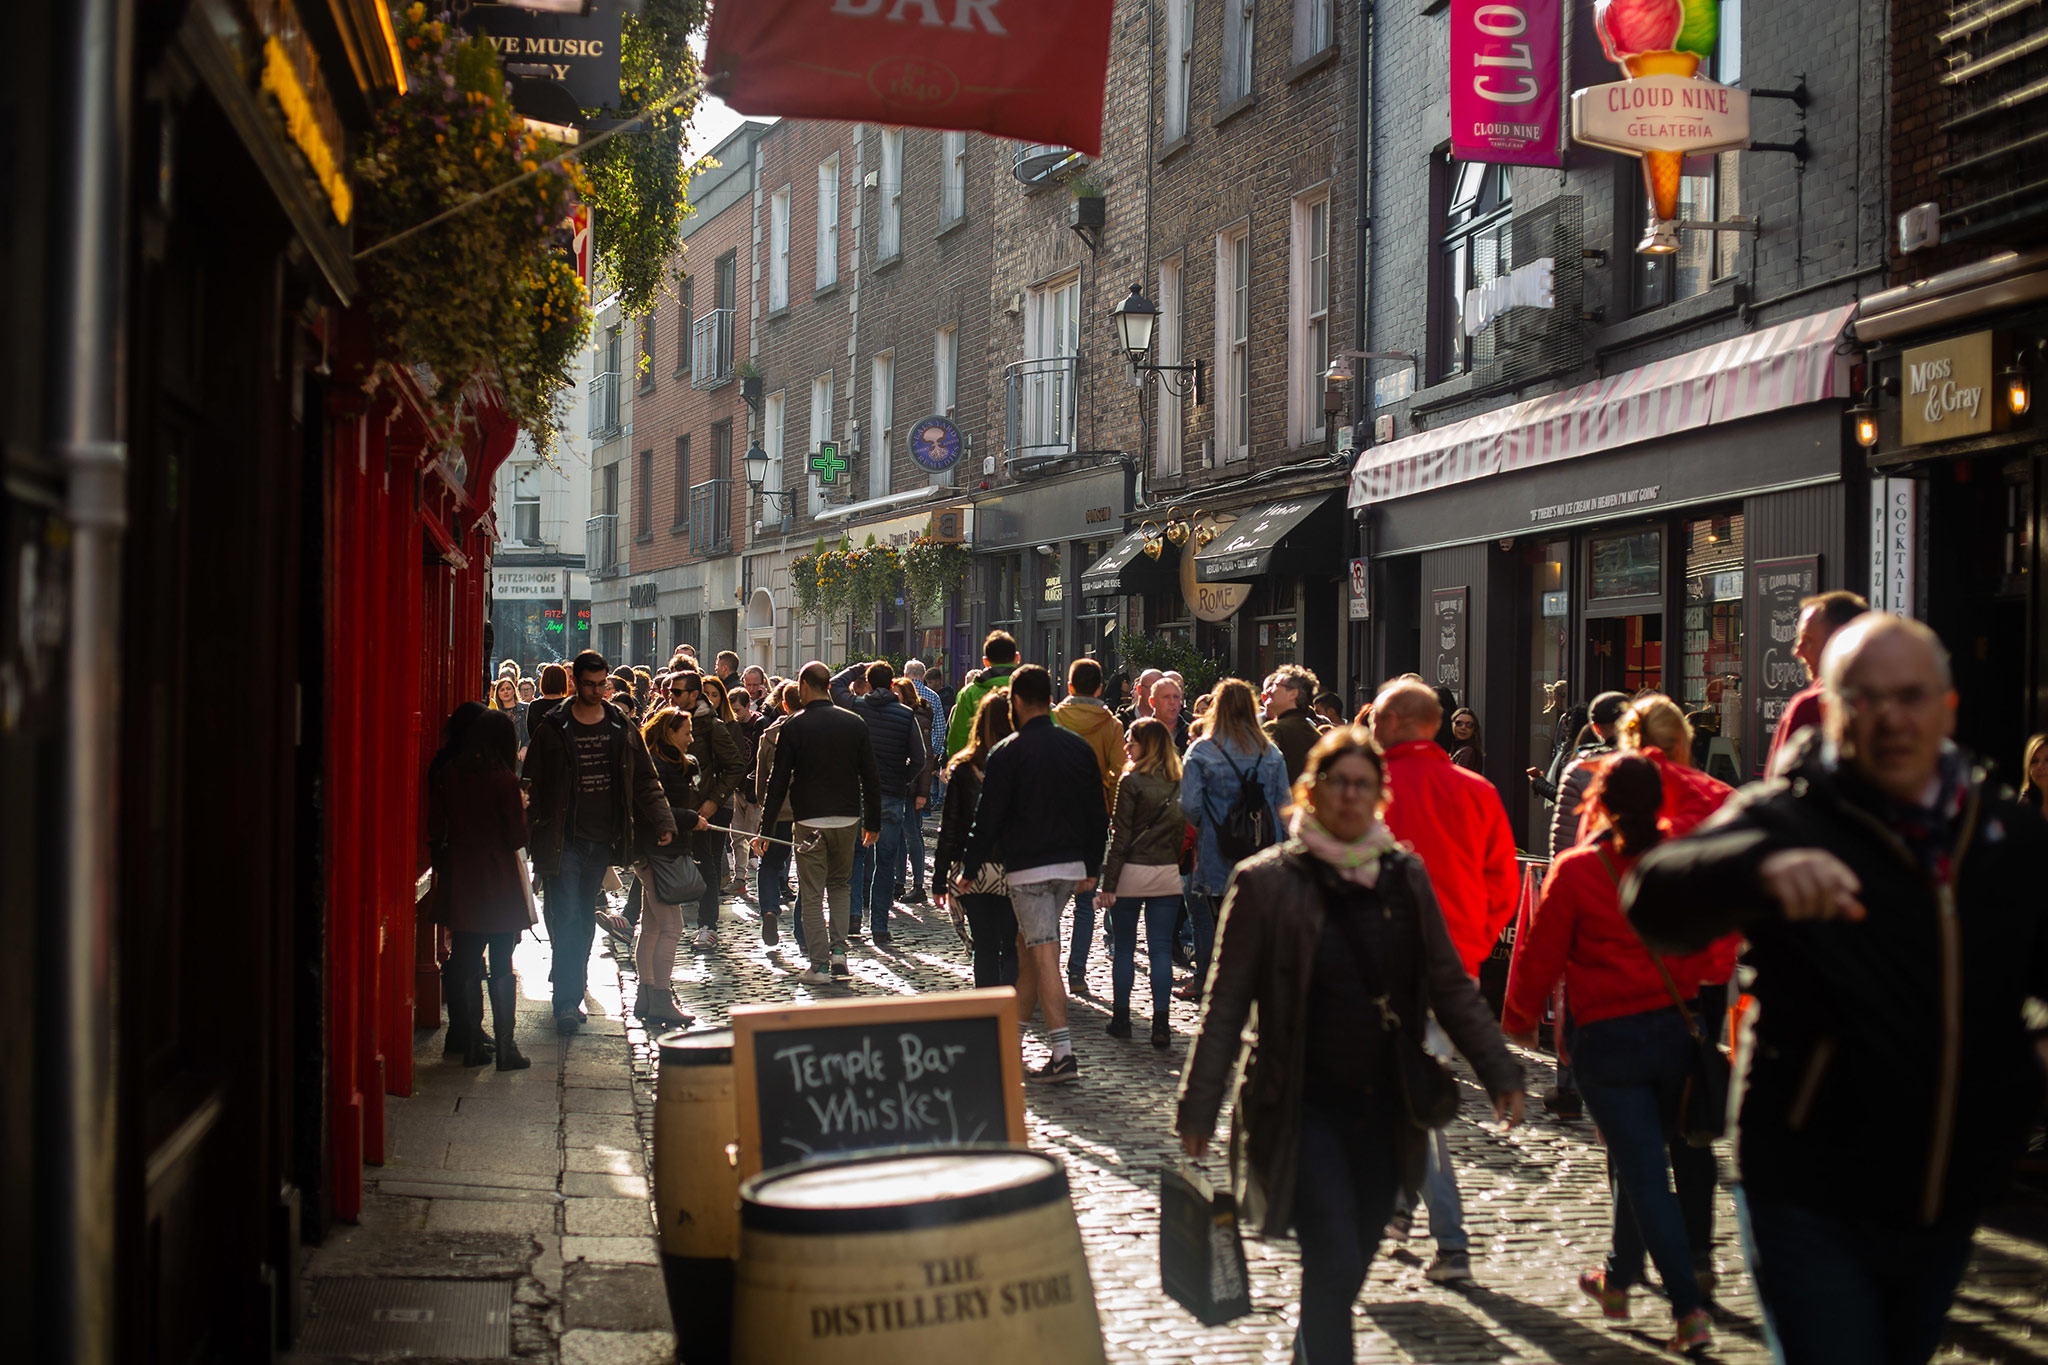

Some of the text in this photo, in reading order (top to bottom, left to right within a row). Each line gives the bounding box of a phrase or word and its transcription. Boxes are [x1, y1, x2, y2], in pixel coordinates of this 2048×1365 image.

[829, 0, 1010, 36] AR
[525, 37, 604, 56] MUSIC
[1608, 87, 1729, 115] CLOUD NINE
[1474, 122, 1540, 140] CLOUD NINE
[1627, 123, 1713, 138] GELATERIA
[1910, 358, 1952, 396] Moss
[1874, 508, 1882, 609] PIZZA
[498, 573, 556, 583] FITZSIMONS
[498, 586, 556, 594] OF TEMPLE BAR
[1198, 587, 1236, 613] ROME
[774, 1033, 967, 1093] Temple Bar
[807, 1080, 960, 1148] Whiskey
[923, 1255, 983, 1288] THE
[809, 1270, 1074, 1340] DISTILLERY STORE
